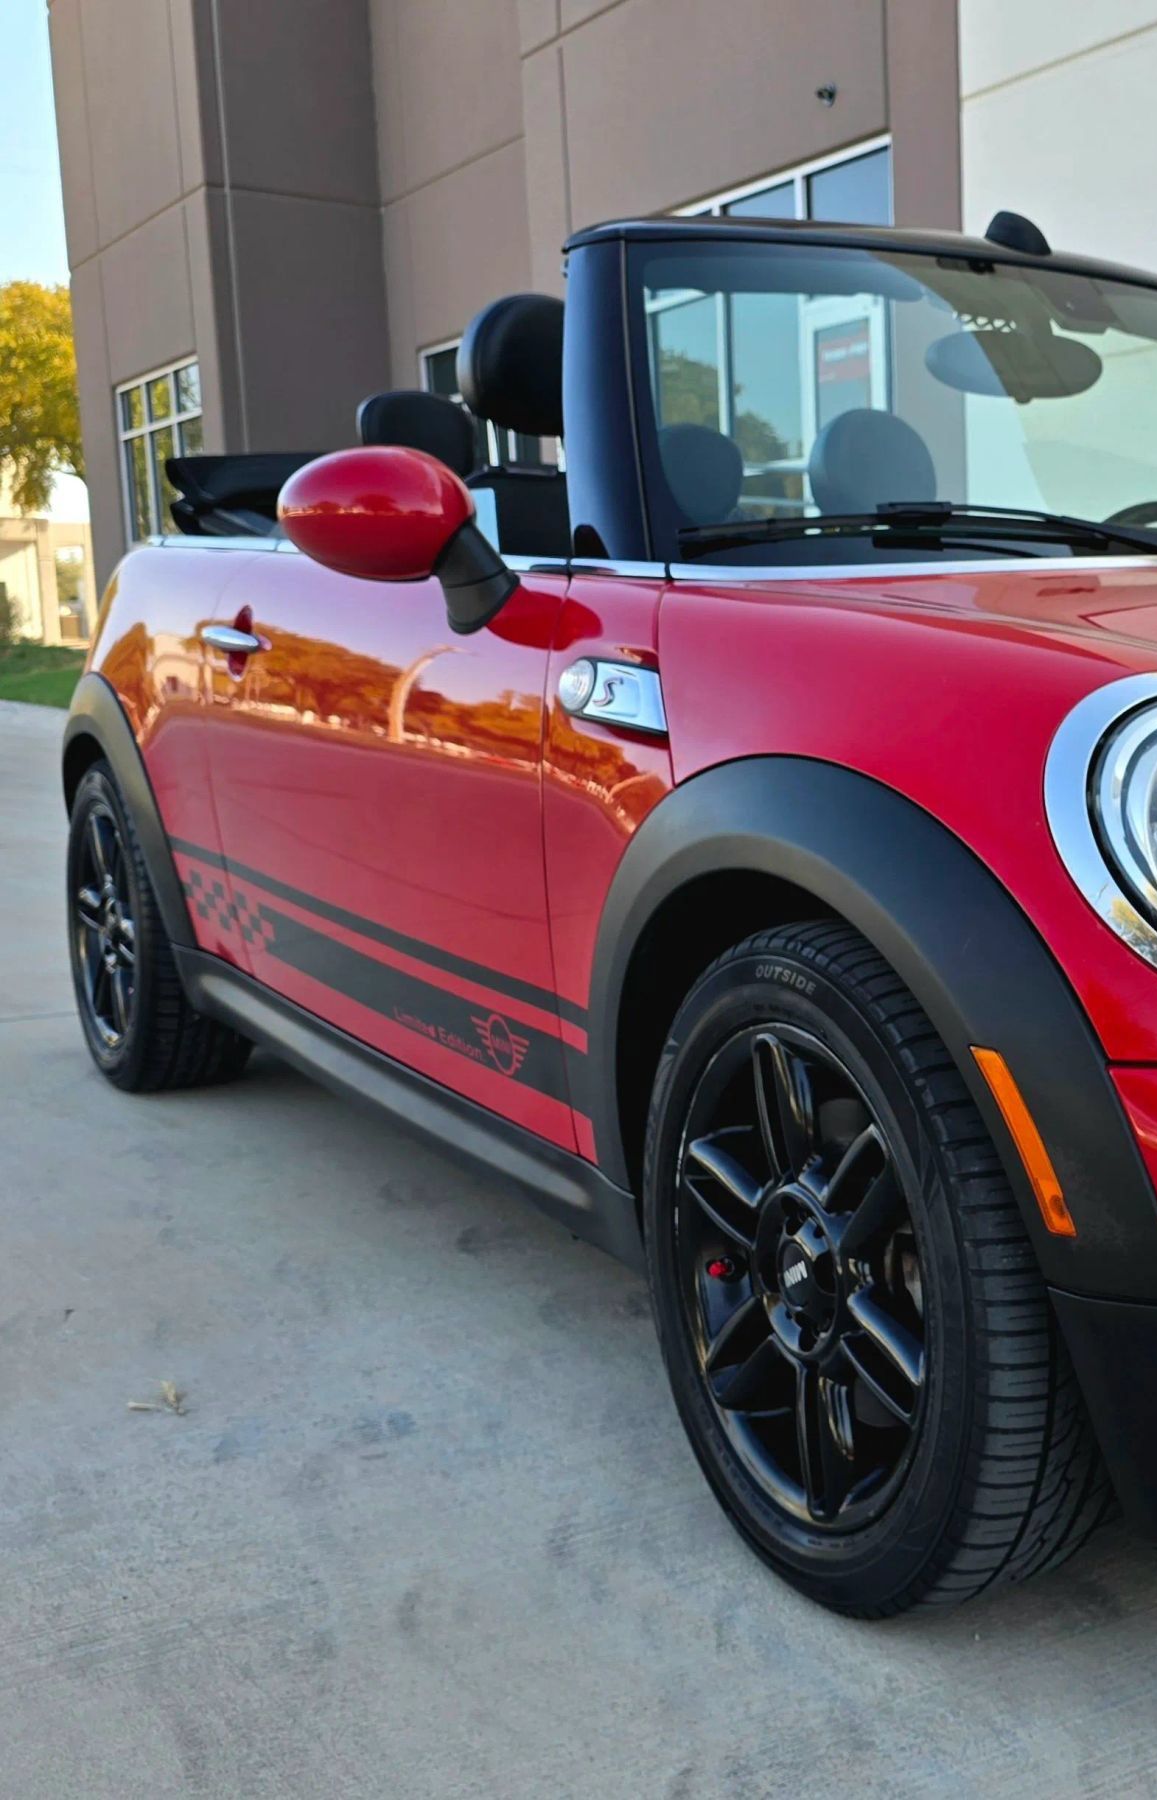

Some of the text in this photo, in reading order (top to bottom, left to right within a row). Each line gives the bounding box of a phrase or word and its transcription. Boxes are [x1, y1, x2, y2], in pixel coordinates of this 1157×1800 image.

[592, 675, 624, 707] S
[754, 964, 817, 996] OUTSIDE
[438, 1026, 482, 1061] Edition
